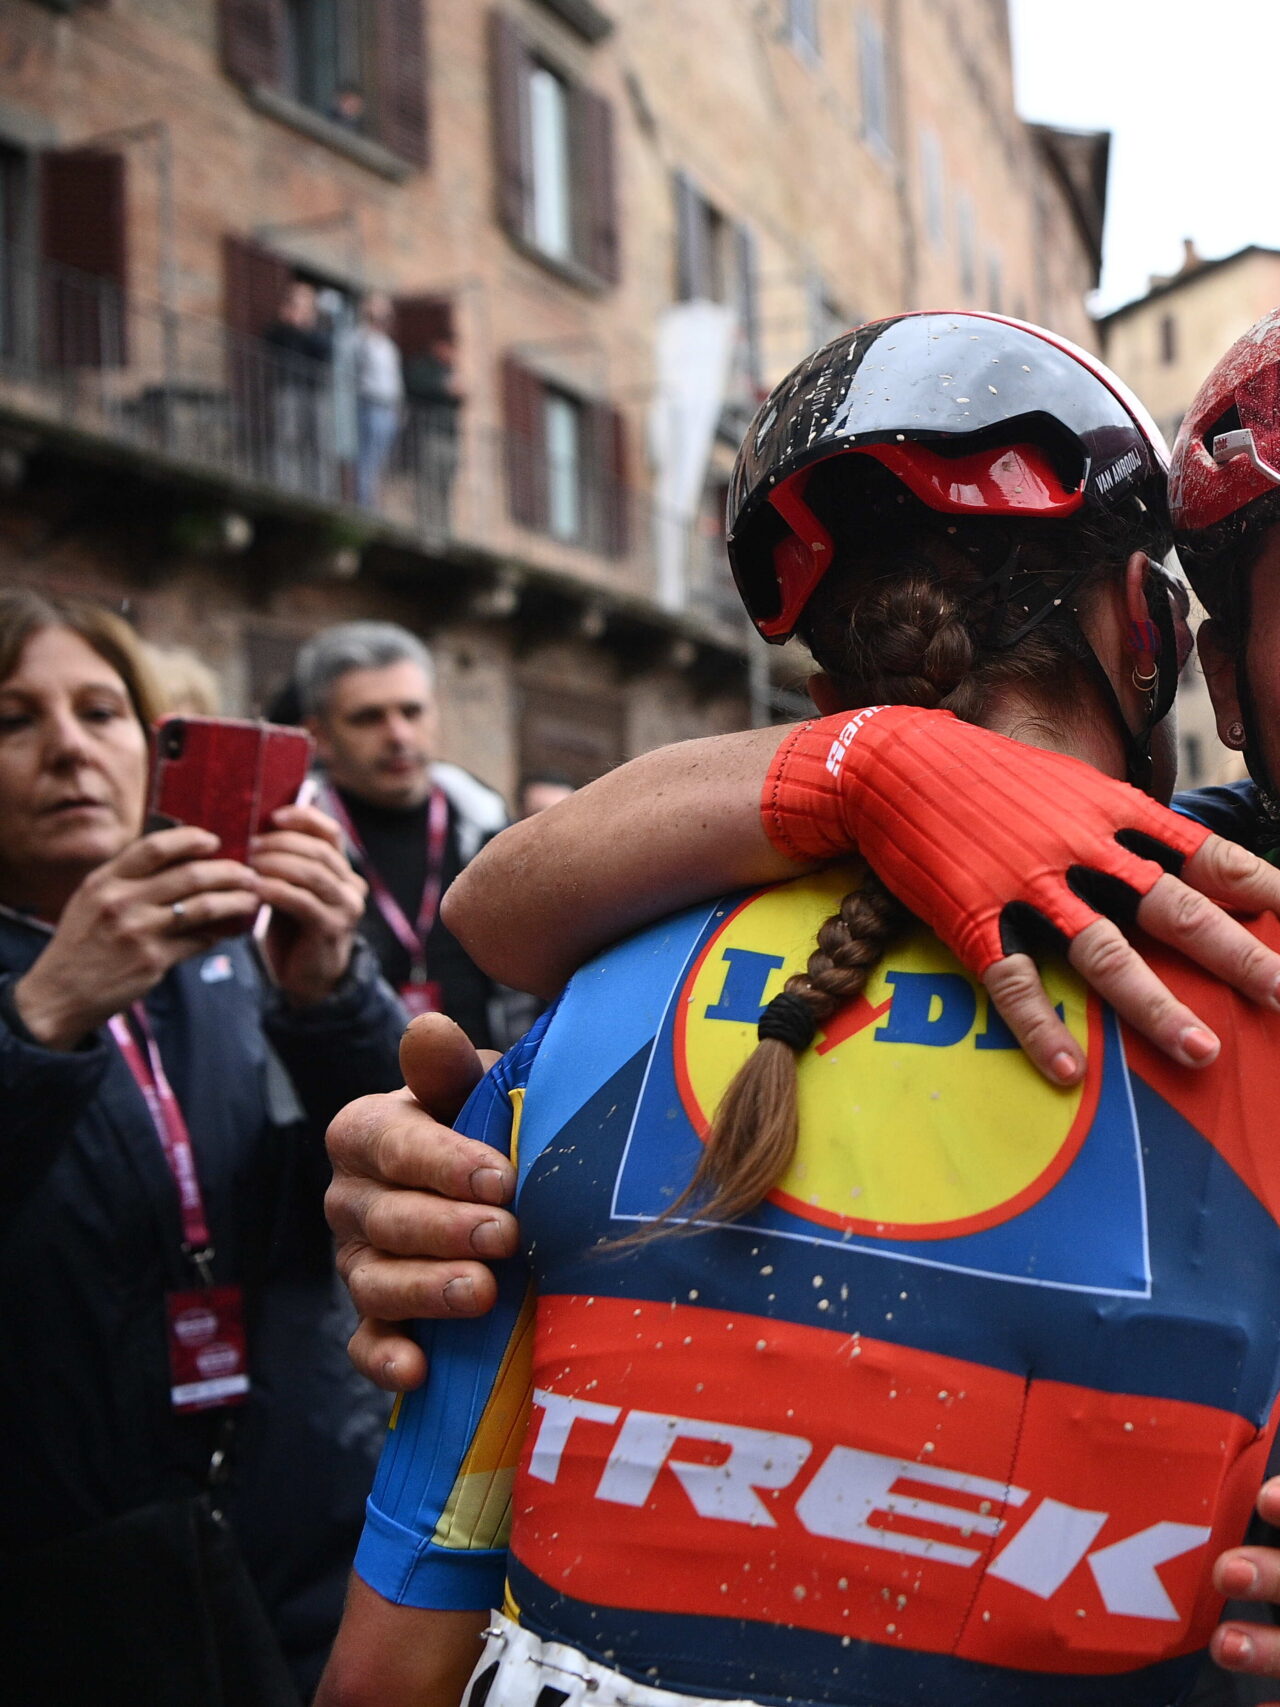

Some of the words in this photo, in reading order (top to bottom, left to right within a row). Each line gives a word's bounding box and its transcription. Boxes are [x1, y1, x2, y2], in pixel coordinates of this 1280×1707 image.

[1095, 469, 1114, 494] VAN
[1111, 447, 1142, 484] ANROOIJ
[527, 1387, 1211, 1622] TREK
